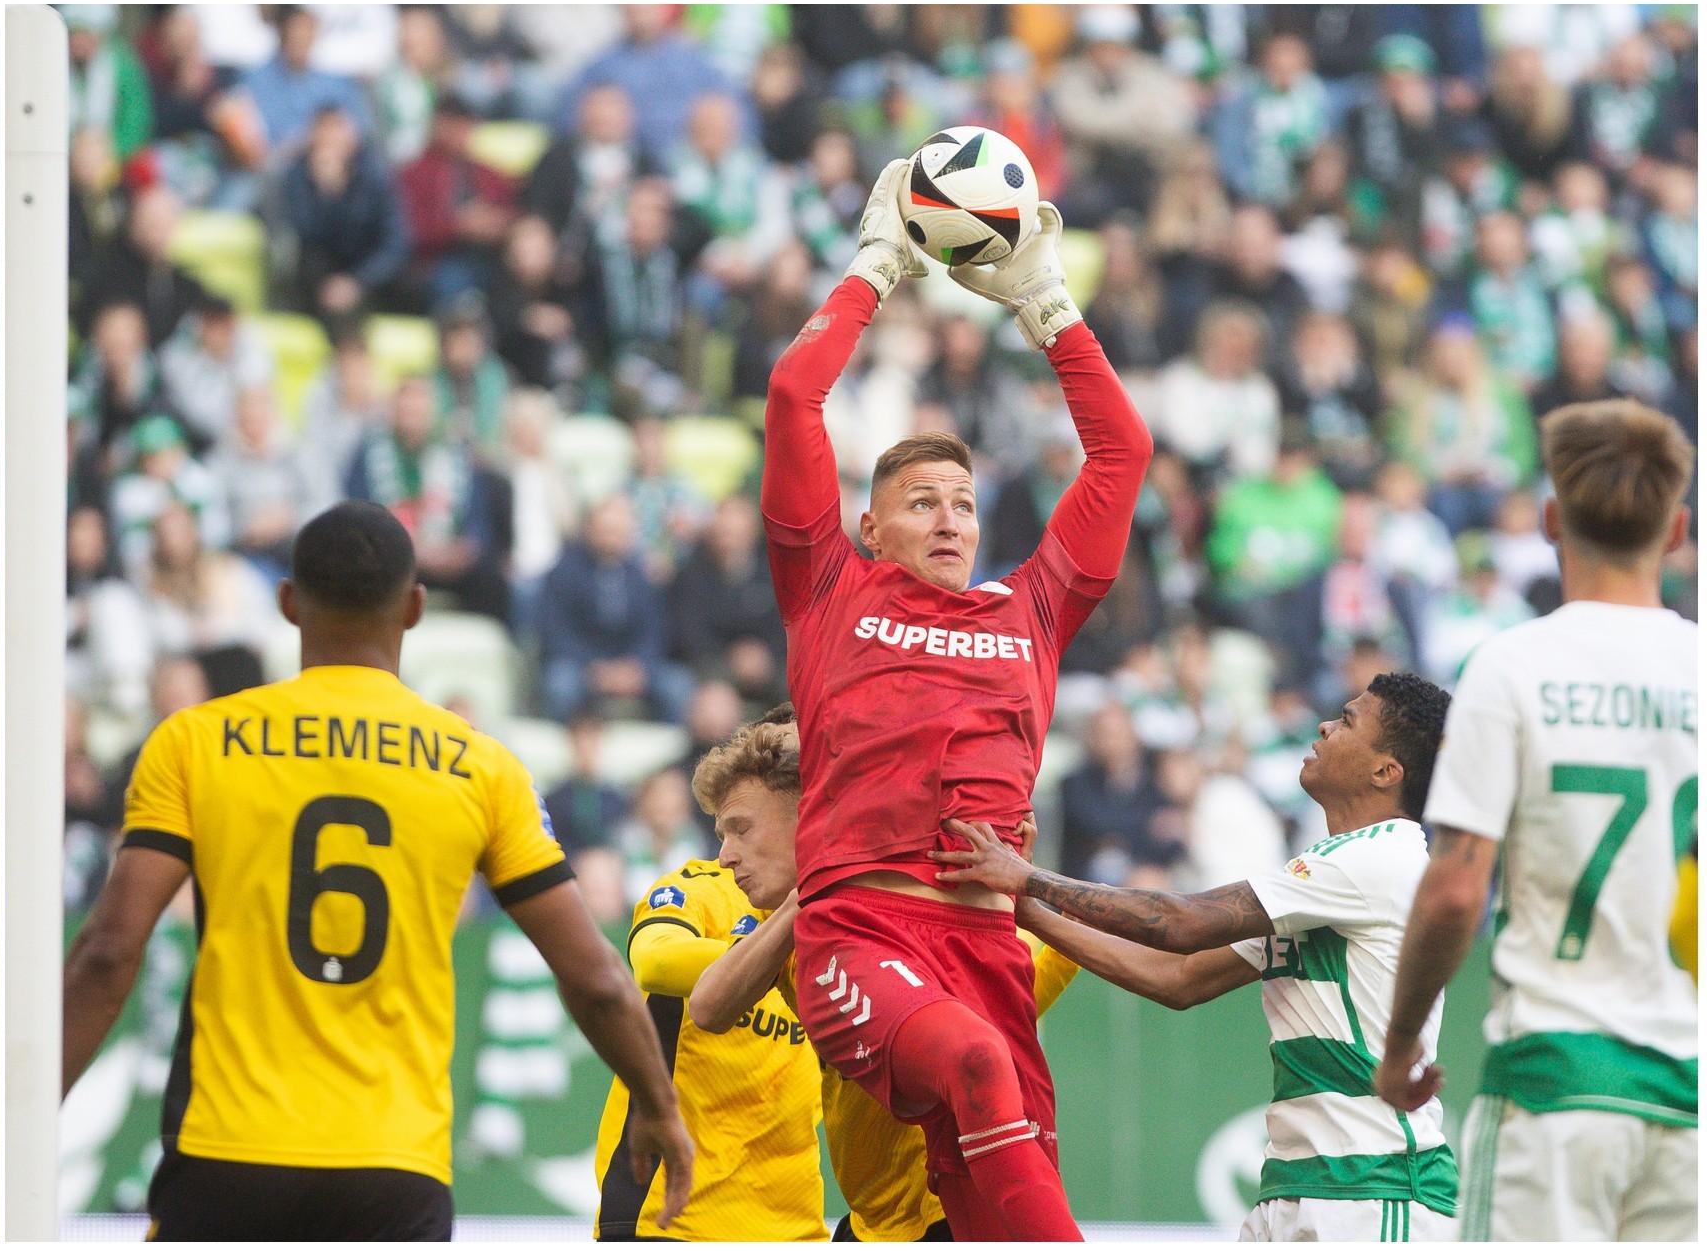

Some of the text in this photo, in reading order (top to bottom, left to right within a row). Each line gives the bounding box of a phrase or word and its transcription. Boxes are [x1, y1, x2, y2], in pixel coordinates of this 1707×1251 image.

[854, 614, 1033, 663] SUPERBET
[221, 715, 473, 780] KLEMENZ
[287, 795, 393, 984] 6
[879, 959, 925, 987] 1
